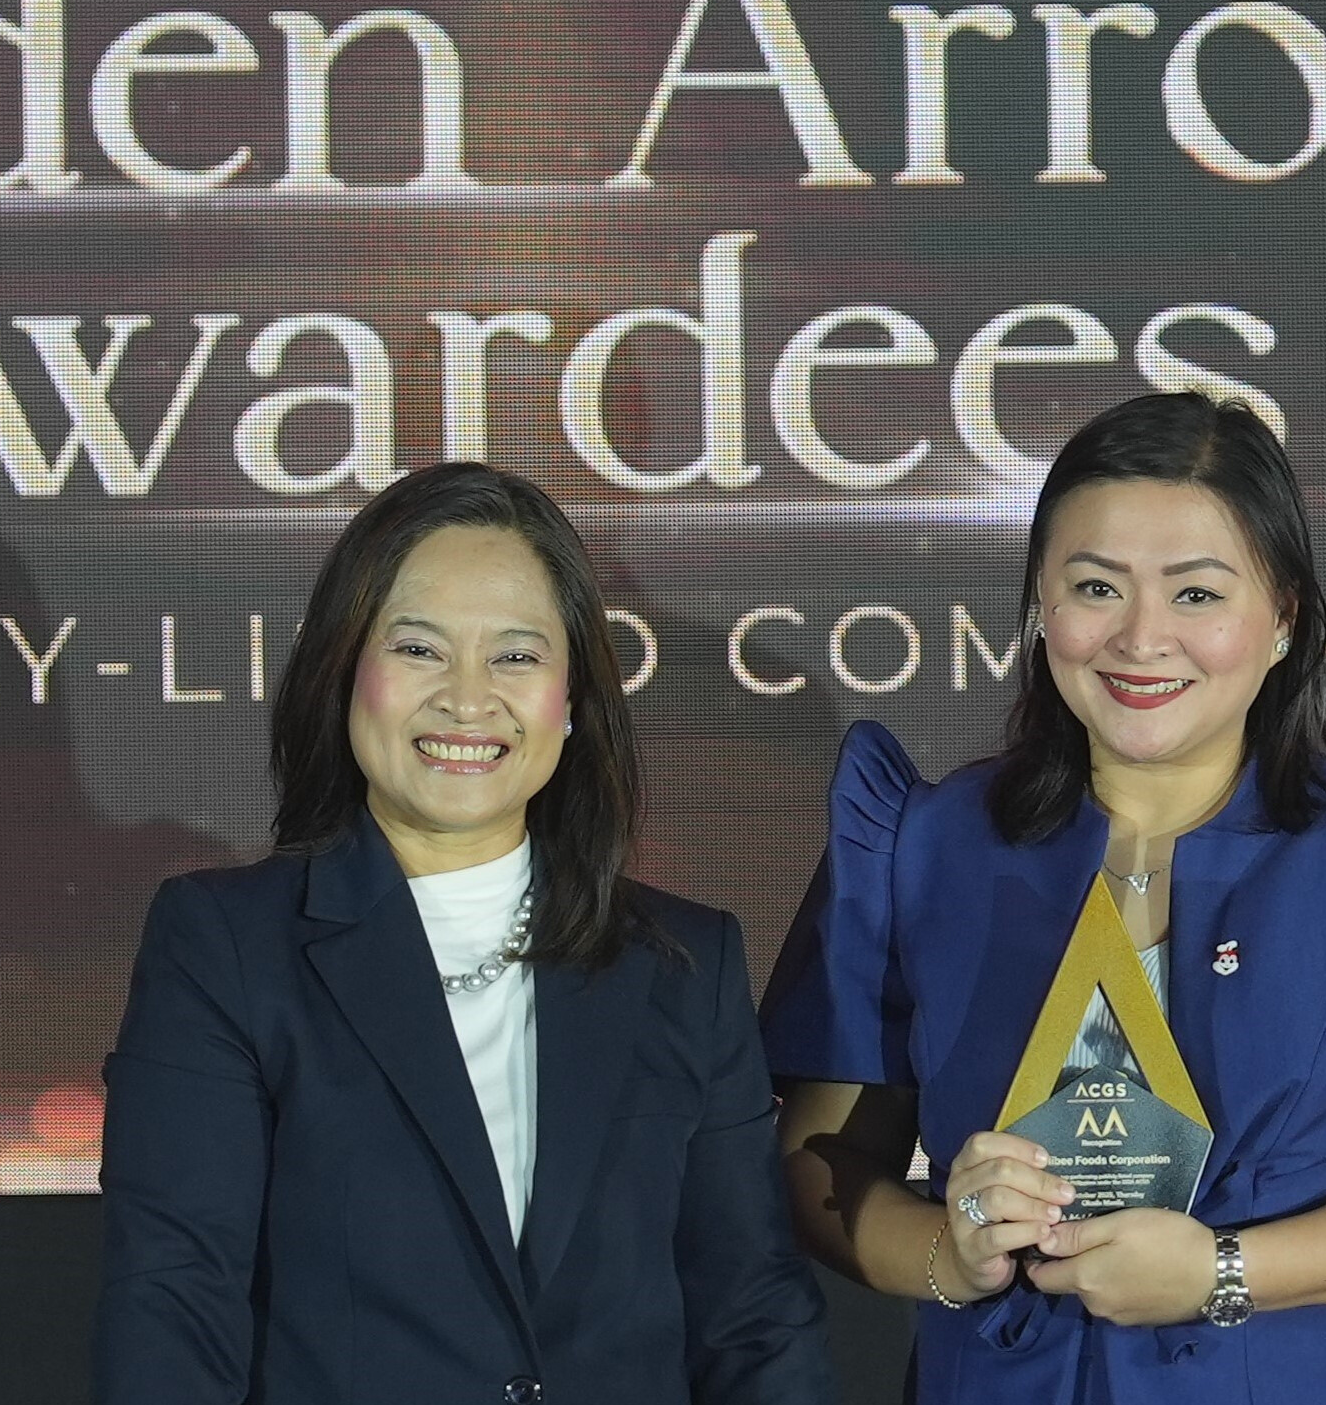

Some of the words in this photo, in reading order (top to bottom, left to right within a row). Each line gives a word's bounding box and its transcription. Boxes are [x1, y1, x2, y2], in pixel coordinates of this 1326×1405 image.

[1075, 1082, 1127, 1098] ACGS
[1075, 1154, 1107, 1166] Foods
[1109, 1153, 1171, 1166] Corporation
